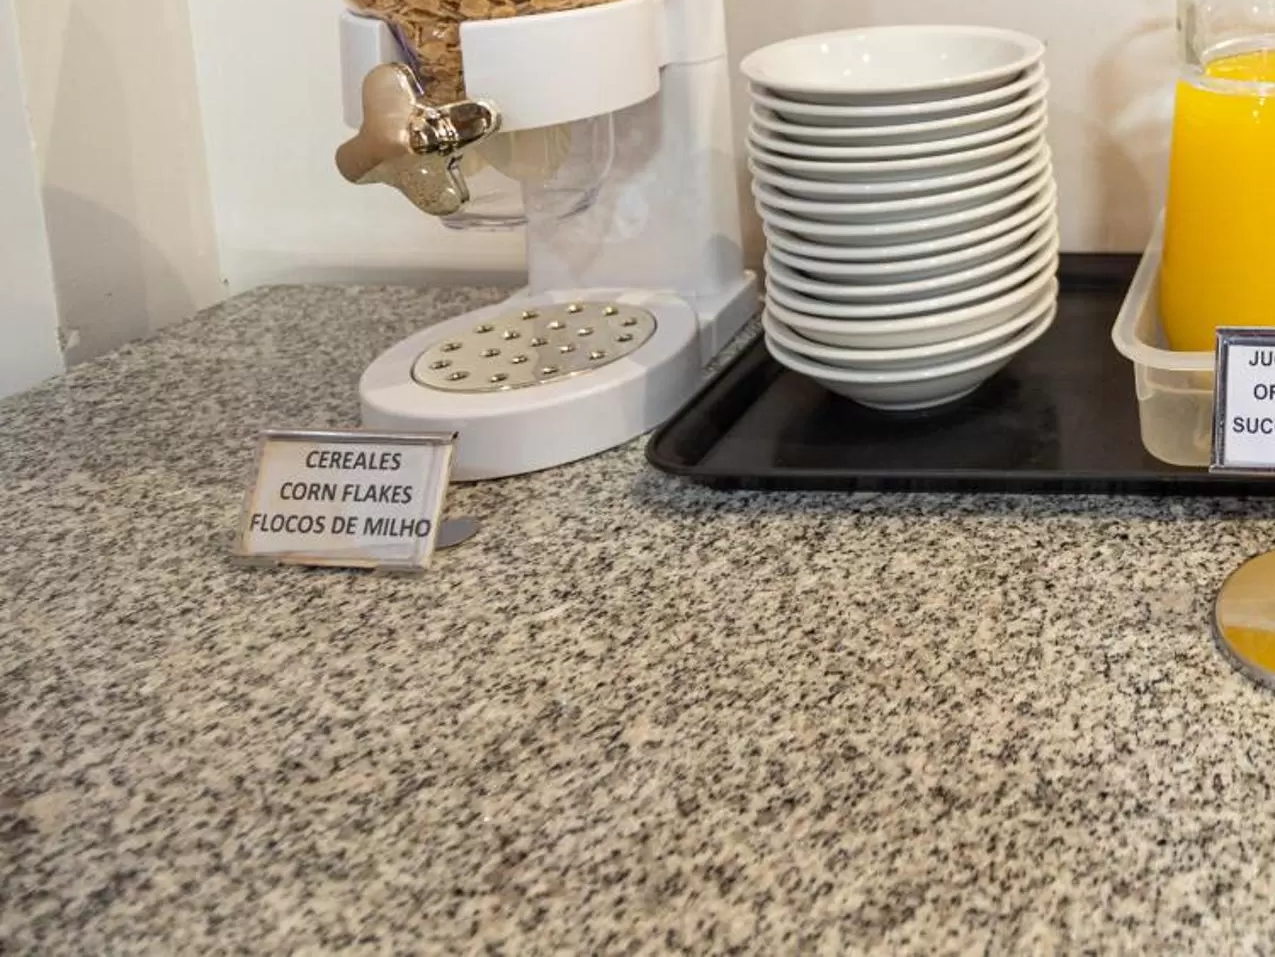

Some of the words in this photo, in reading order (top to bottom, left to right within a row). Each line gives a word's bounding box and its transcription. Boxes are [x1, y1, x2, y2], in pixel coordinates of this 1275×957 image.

[305, 450, 402, 471] CEREALES
[279, 482, 336, 501] CORN
[341, 484, 413, 504] FLAKES
[250, 513, 326, 534] FLOCOS
[331, 516, 358, 535] DE
[363, 517, 431, 538] MILHO
